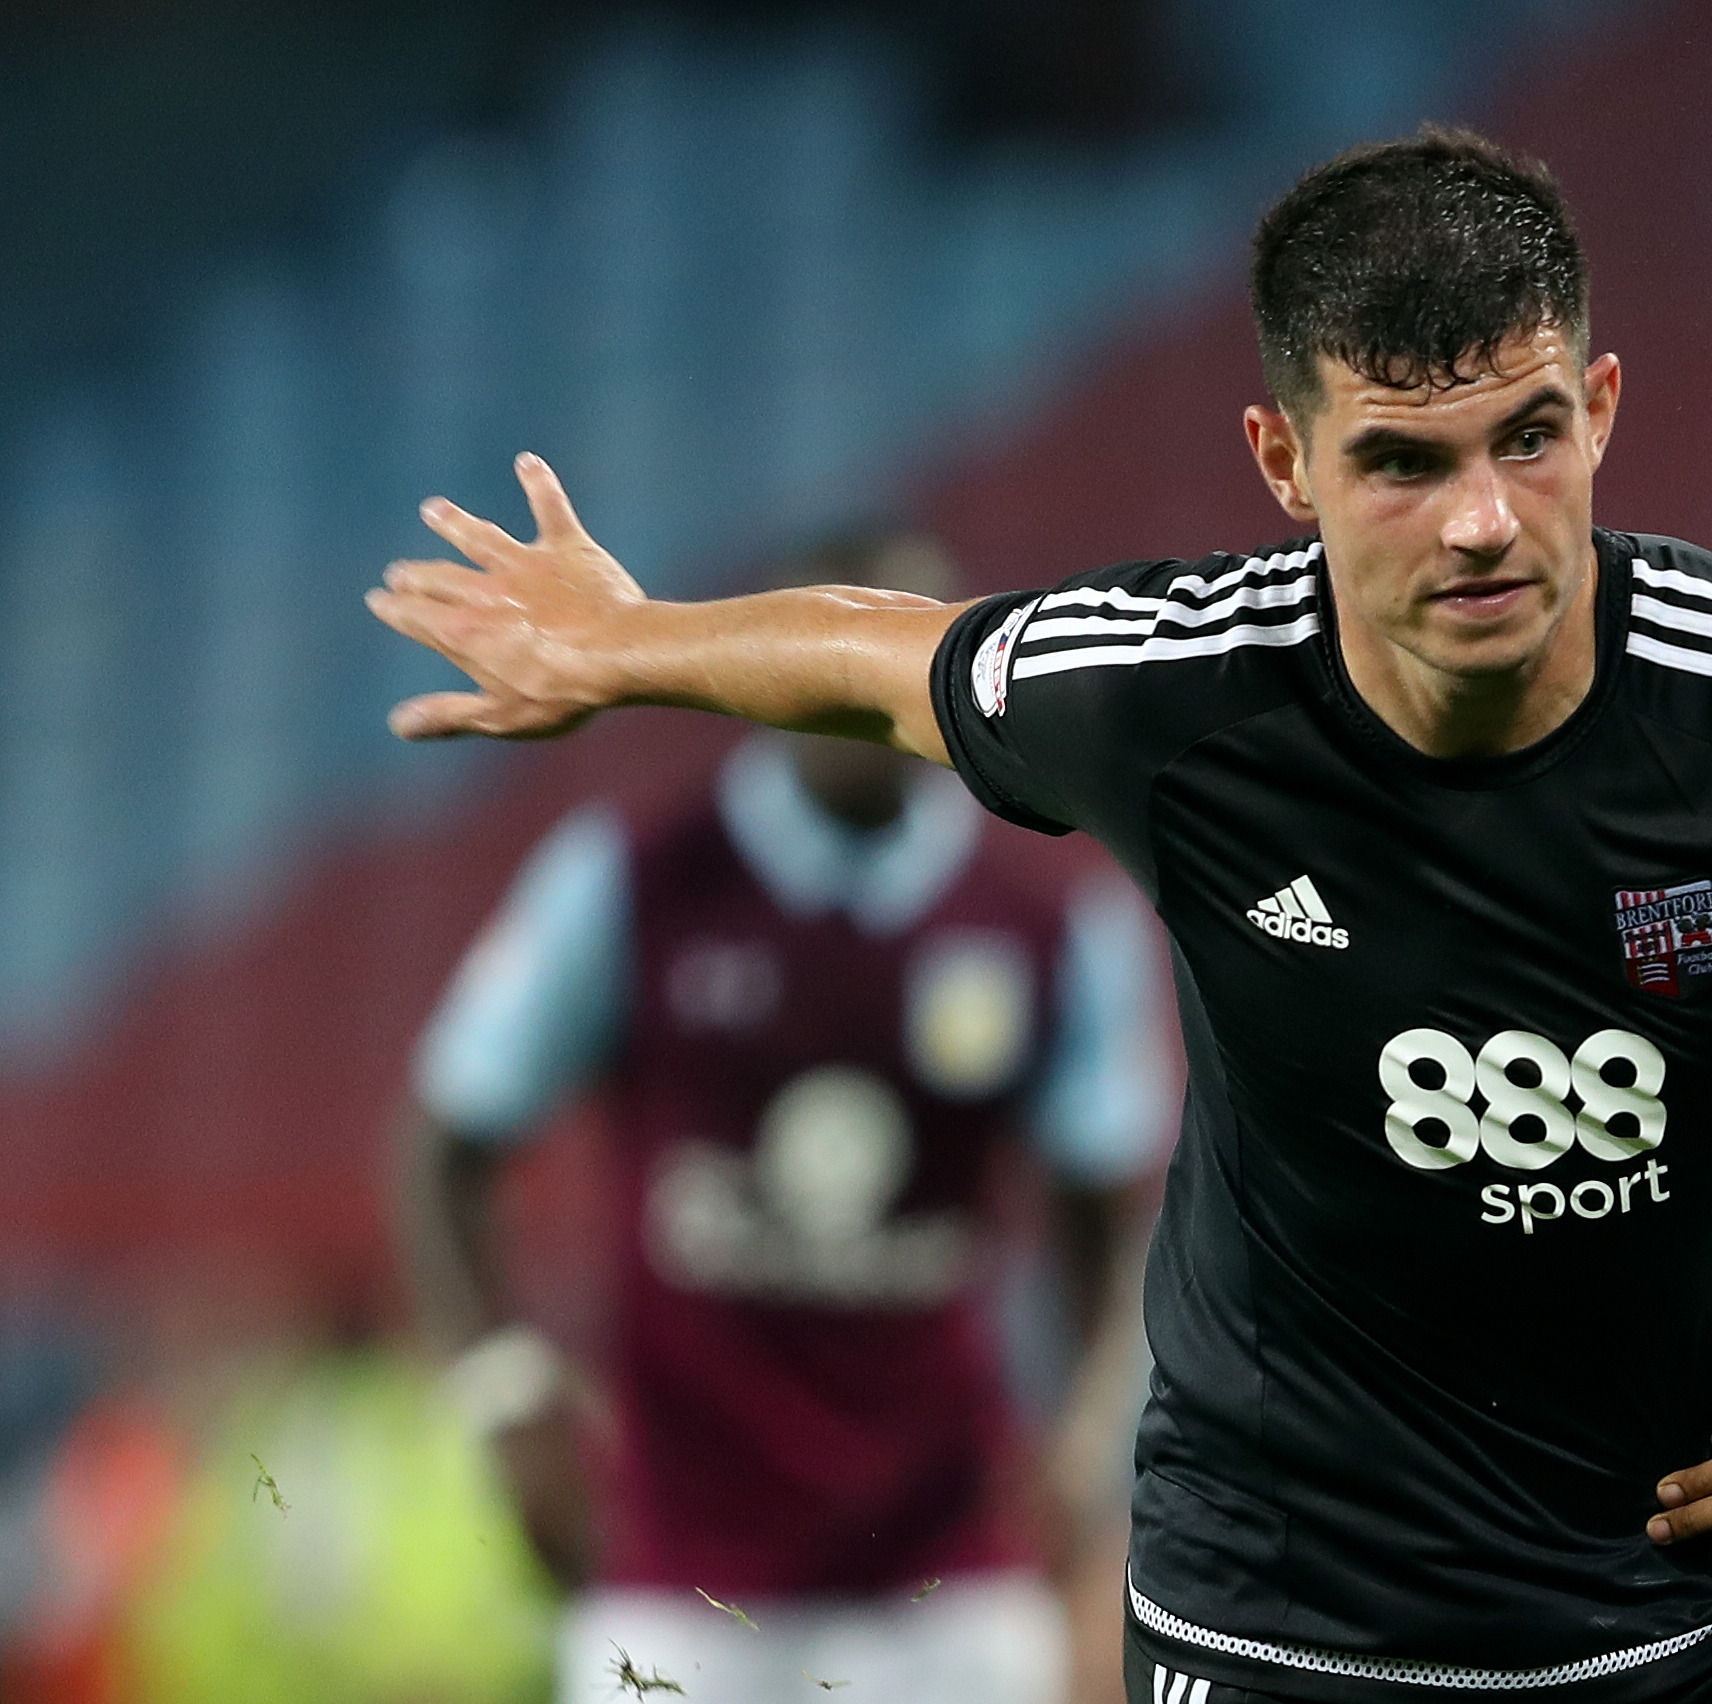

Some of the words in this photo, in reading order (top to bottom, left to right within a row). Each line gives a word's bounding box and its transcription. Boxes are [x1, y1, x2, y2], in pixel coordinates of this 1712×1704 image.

[1246, 909, 1350, 949] adidas
[1378, 1028, 1667, 1170] 888
[1480, 1158, 1671, 1235] sport
